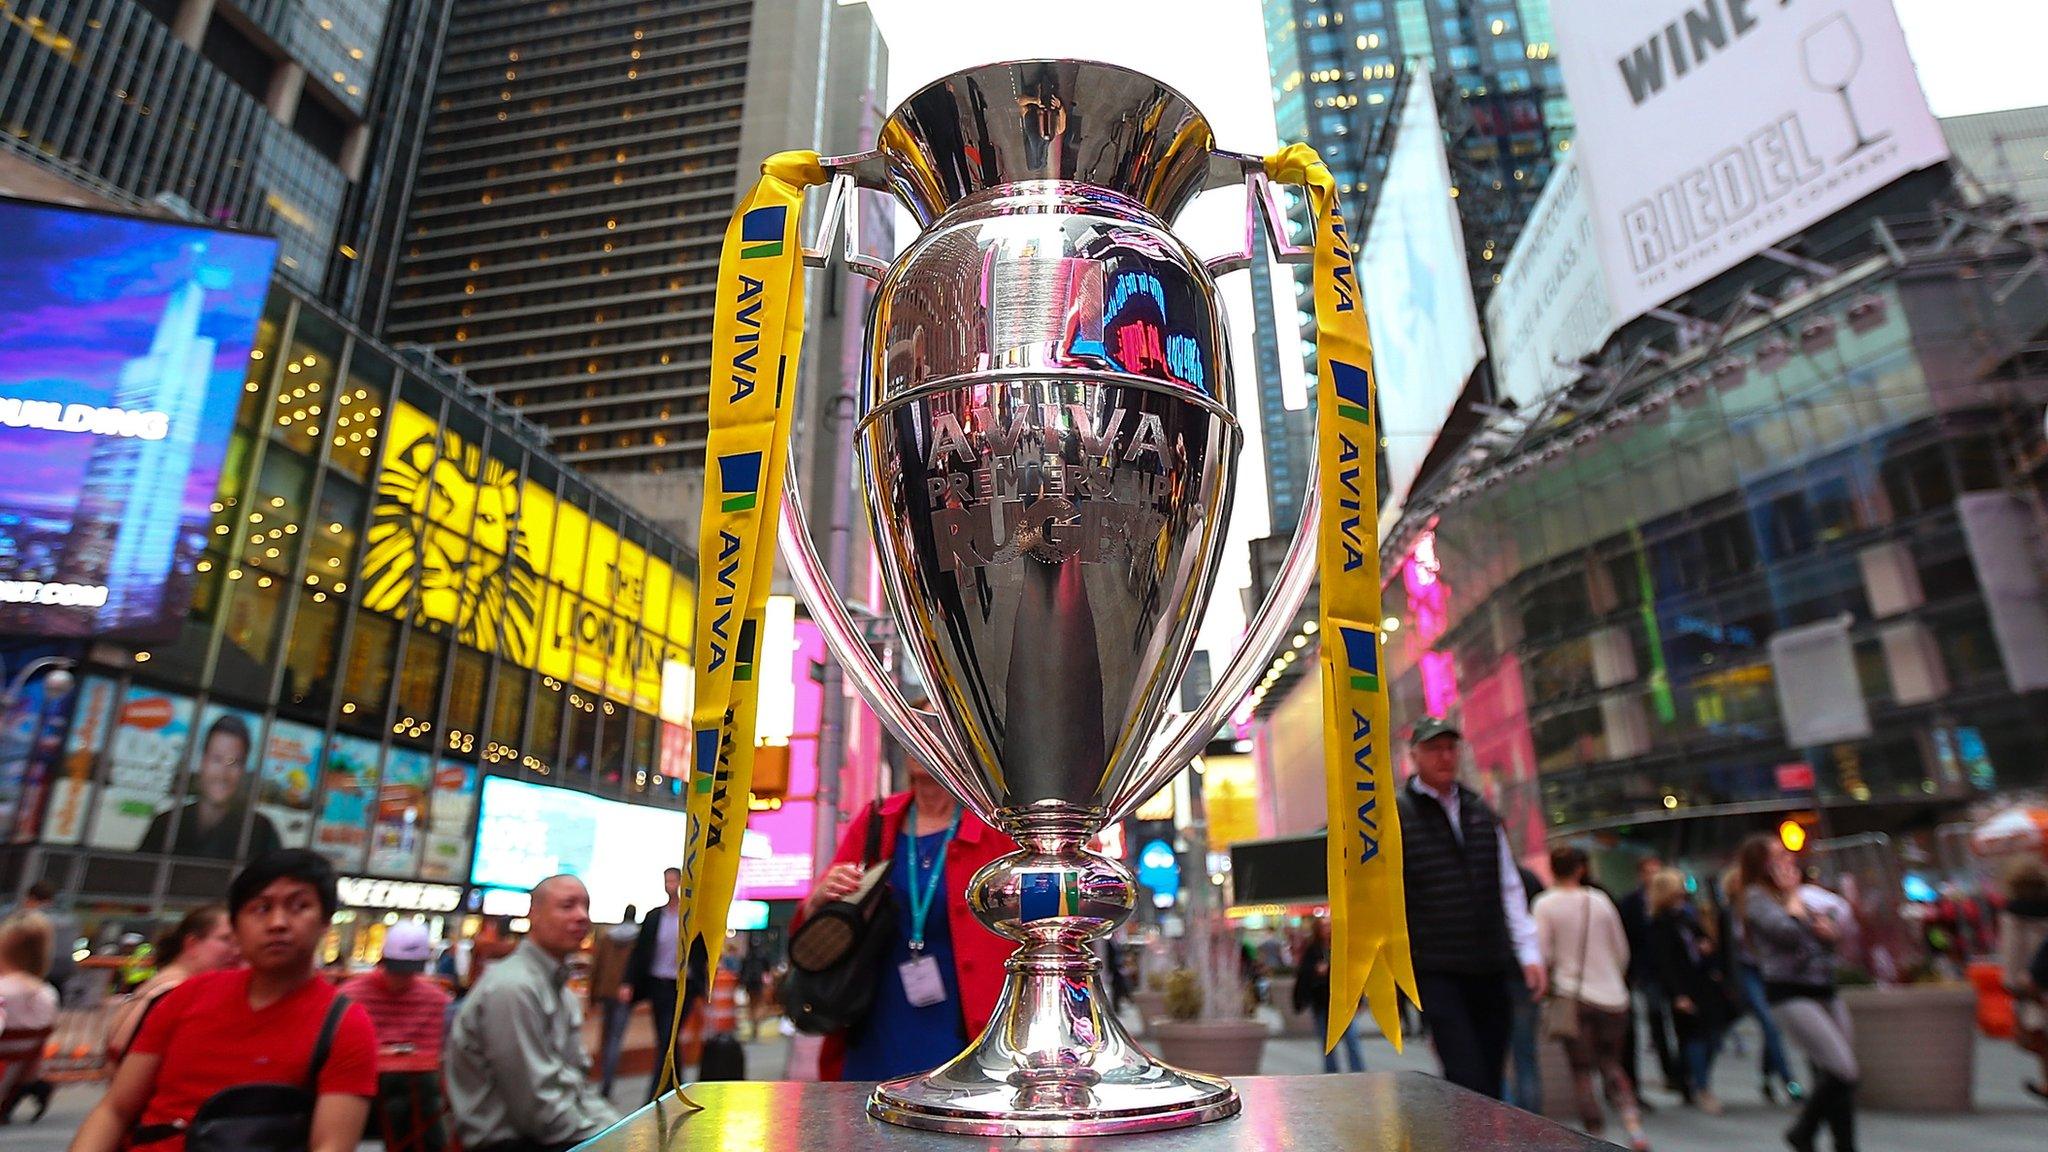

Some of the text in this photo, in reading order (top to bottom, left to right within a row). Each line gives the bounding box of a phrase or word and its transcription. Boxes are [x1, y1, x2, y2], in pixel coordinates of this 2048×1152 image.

[1617, 0, 1759, 107] WINE
[1619, 109, 1824, 275] RIEDEL
[730, 274, 764, 404] AVIVA
[926, 403, 1173, 471] AVIVA
[927, 462, 1173, 510] PREMIERSHIP
[1338, 431, 1363, 573] AVIVA
[707, 530, 741, 674] AVIVA
[1352, 708, 1379, 865] AVIVA
